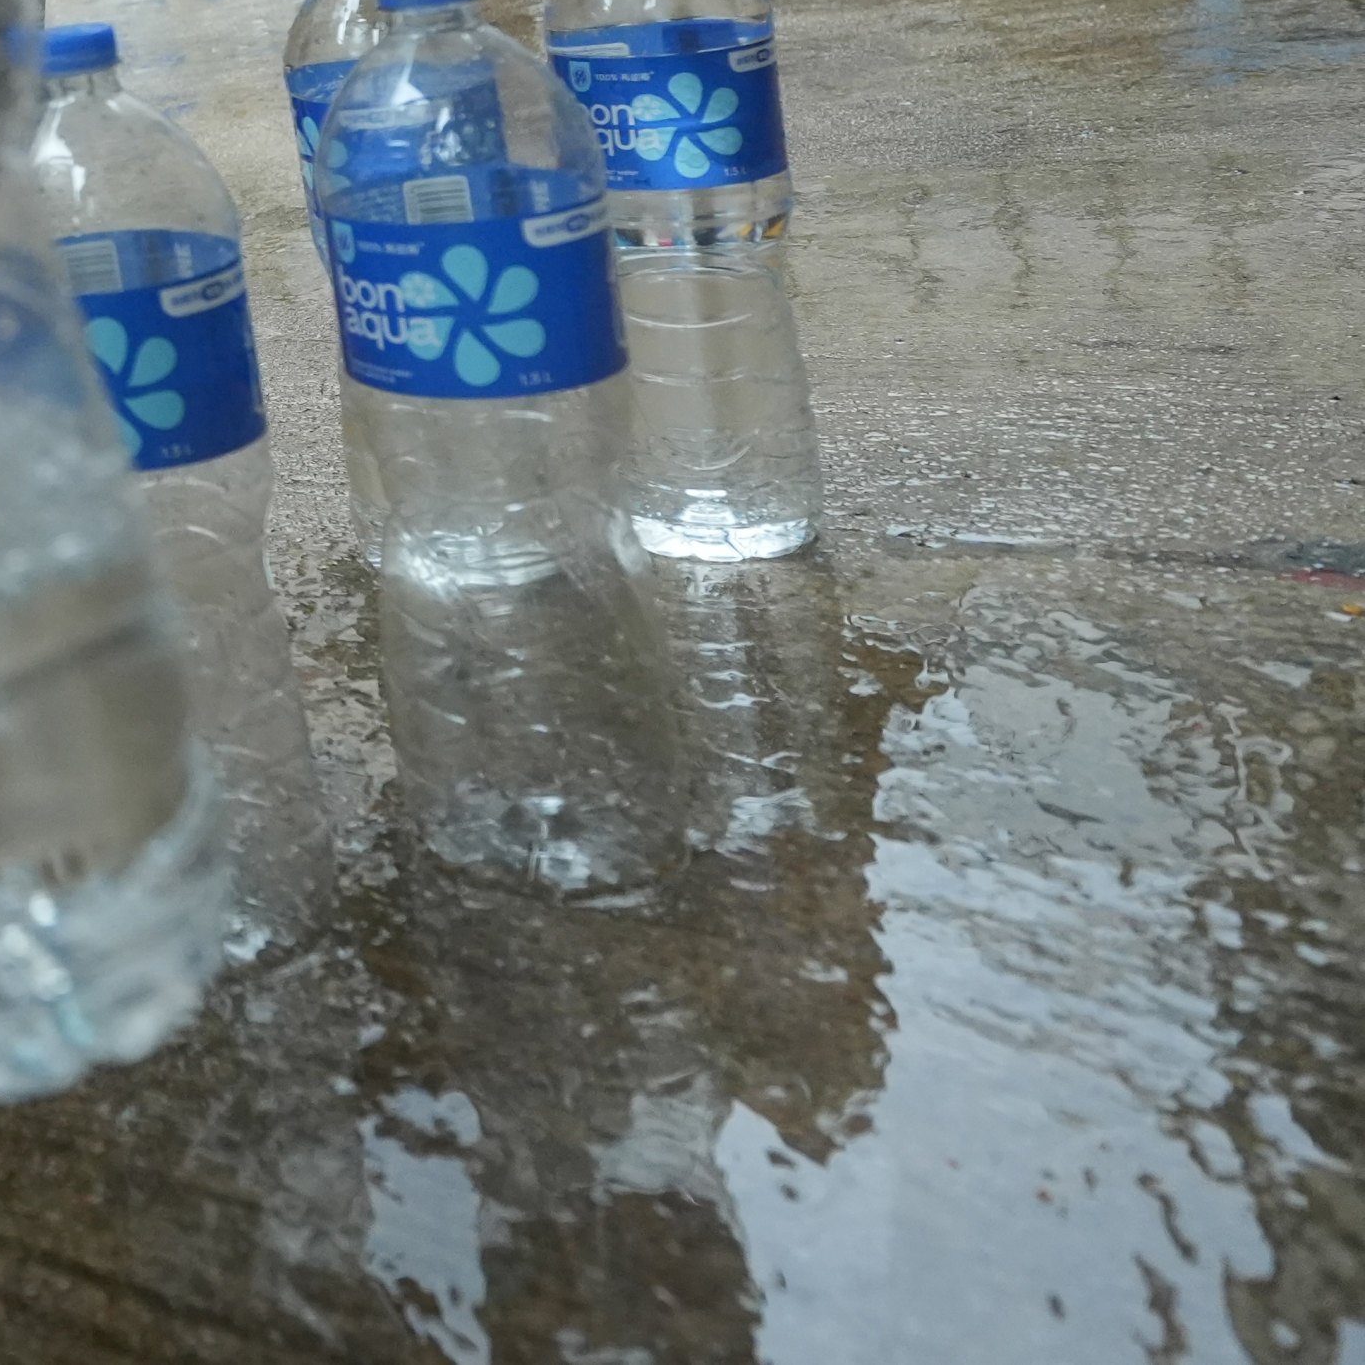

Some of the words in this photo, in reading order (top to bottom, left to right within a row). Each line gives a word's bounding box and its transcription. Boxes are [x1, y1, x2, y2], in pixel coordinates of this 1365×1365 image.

[589, 103, 636, 126] on
[595, 128, 664, 157] qua
[335, 262, 406, 313] bon
[344, 305, 442, 351] aqua
